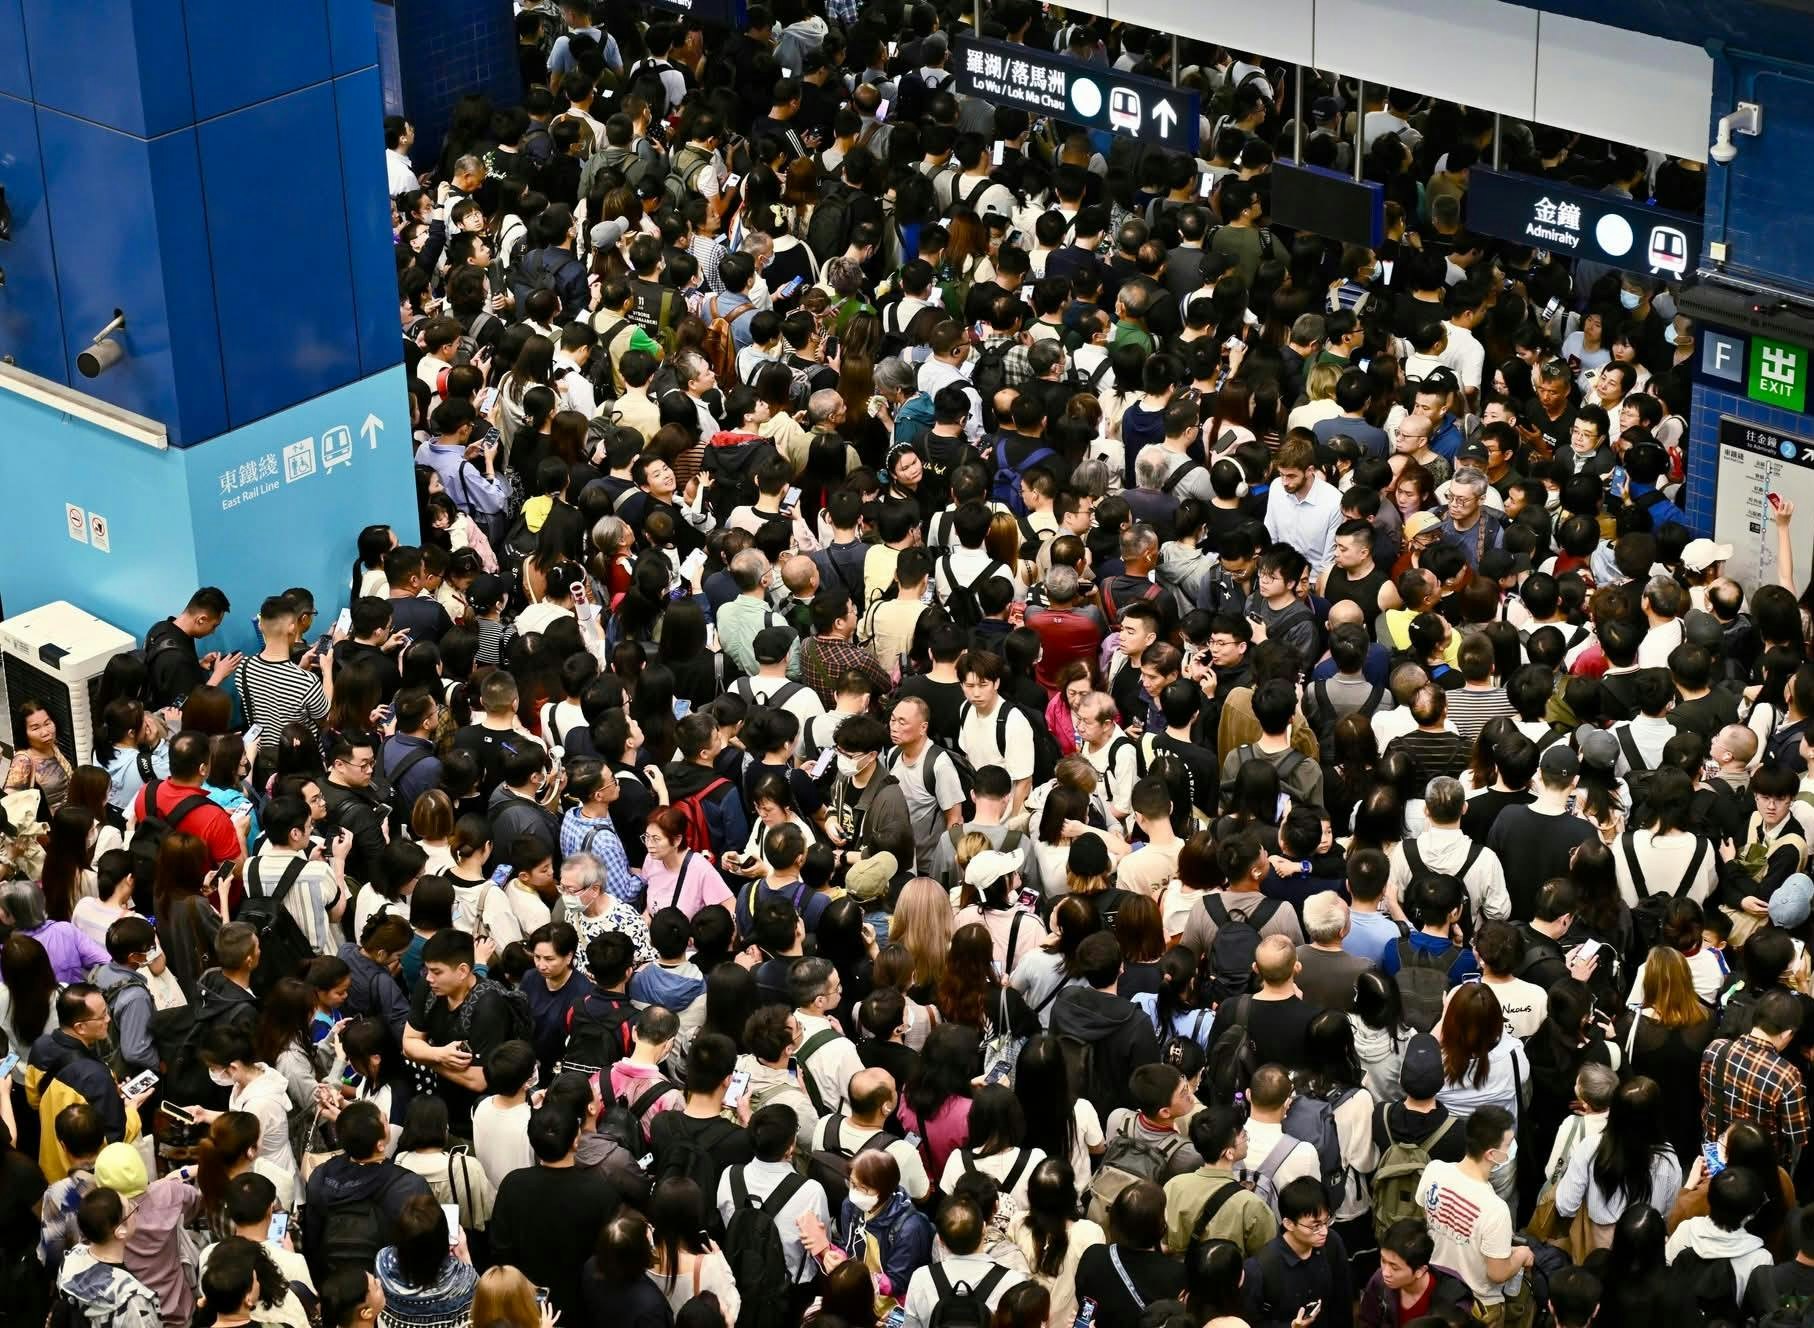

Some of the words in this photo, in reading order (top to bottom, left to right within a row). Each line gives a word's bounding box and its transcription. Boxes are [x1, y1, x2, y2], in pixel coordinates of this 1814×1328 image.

[967, 49, 1065, 96] 羅湖/落馬洲
[973, 77, 984, 89] Lo
[985, 80, 1001, 94] Wu
[1008, 86, 1025, 100] Lok
[1025, 90, 1040, 104] Ma
[1041, 95, 1065, 111] Chau
[1534, 197, 1580, 231] 金鐘
[1525, 222, 1580, 249] Admiralty
[1715, 341, 1732, 370] F
[1761, 346, 1796, 385] 出
[1760, 378, 1794, 397] EXIT
[1785, 443, 1793, 456] 2
[219, 453, 278, 496] 東鐵綫
[222, 495, 241, 511] East
[242, 486, 259, 502] Rail
[260, 480, 280, 495] Line
